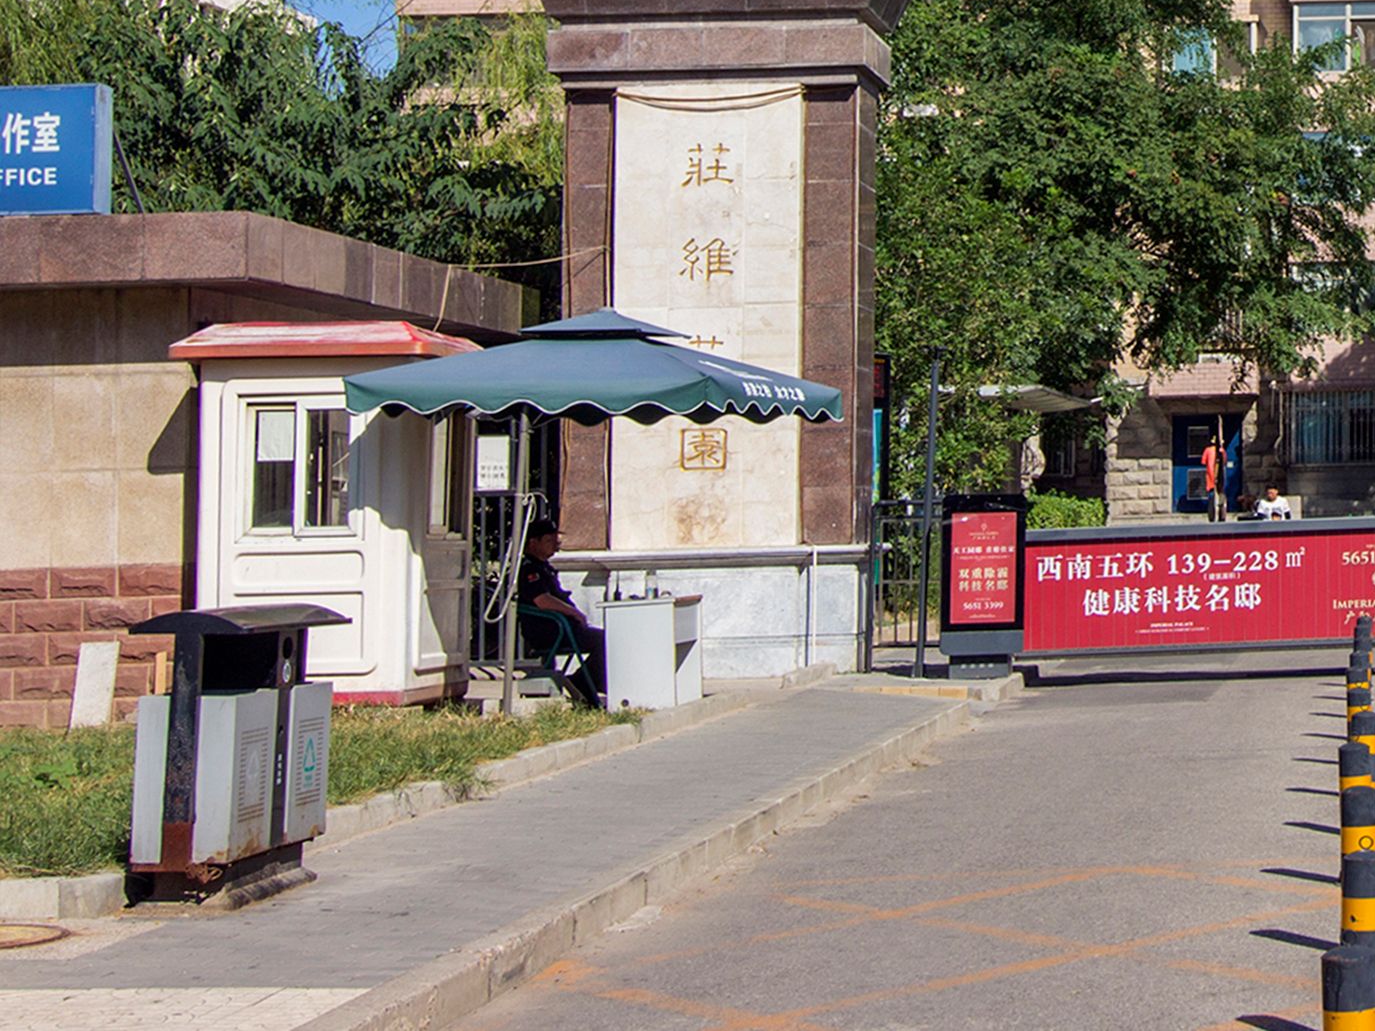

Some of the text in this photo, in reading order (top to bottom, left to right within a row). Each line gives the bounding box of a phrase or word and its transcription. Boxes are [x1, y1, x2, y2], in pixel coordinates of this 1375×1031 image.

[2, 111, 60, 155] 作室
[0, 167, 58, 187] FICE
[1036, 551, 1154, 582] 西南五环
[1341, 551, 1375, 566] 5651
[1082, 582, 1262, 617] 健康科技名邸
